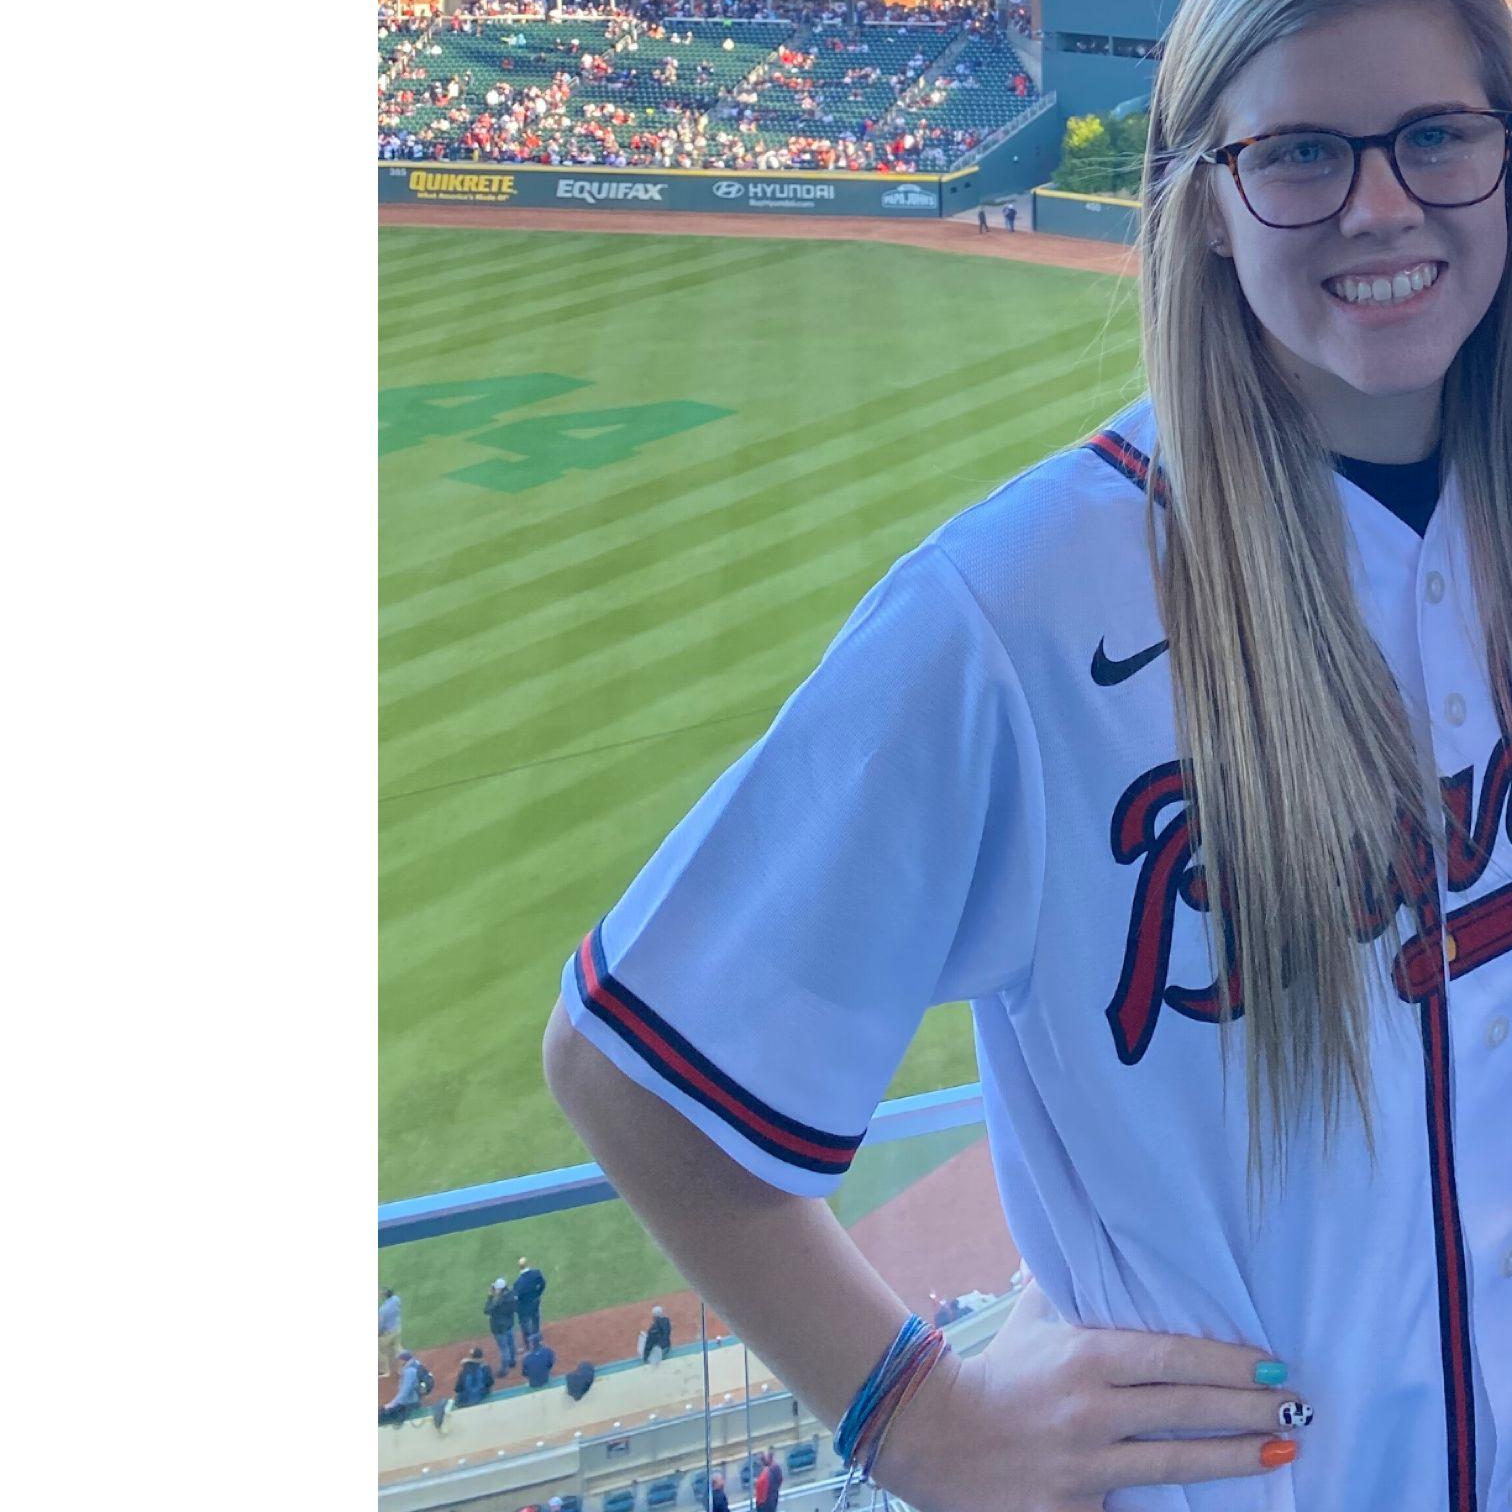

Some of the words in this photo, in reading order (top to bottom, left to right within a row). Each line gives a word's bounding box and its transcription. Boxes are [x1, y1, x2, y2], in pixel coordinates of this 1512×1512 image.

[409, 170, 516, 193] QUIKRETE
[556, 179, 663, 204] EQUIFAX
[749, 183, 834, 200] HYUNDAI
